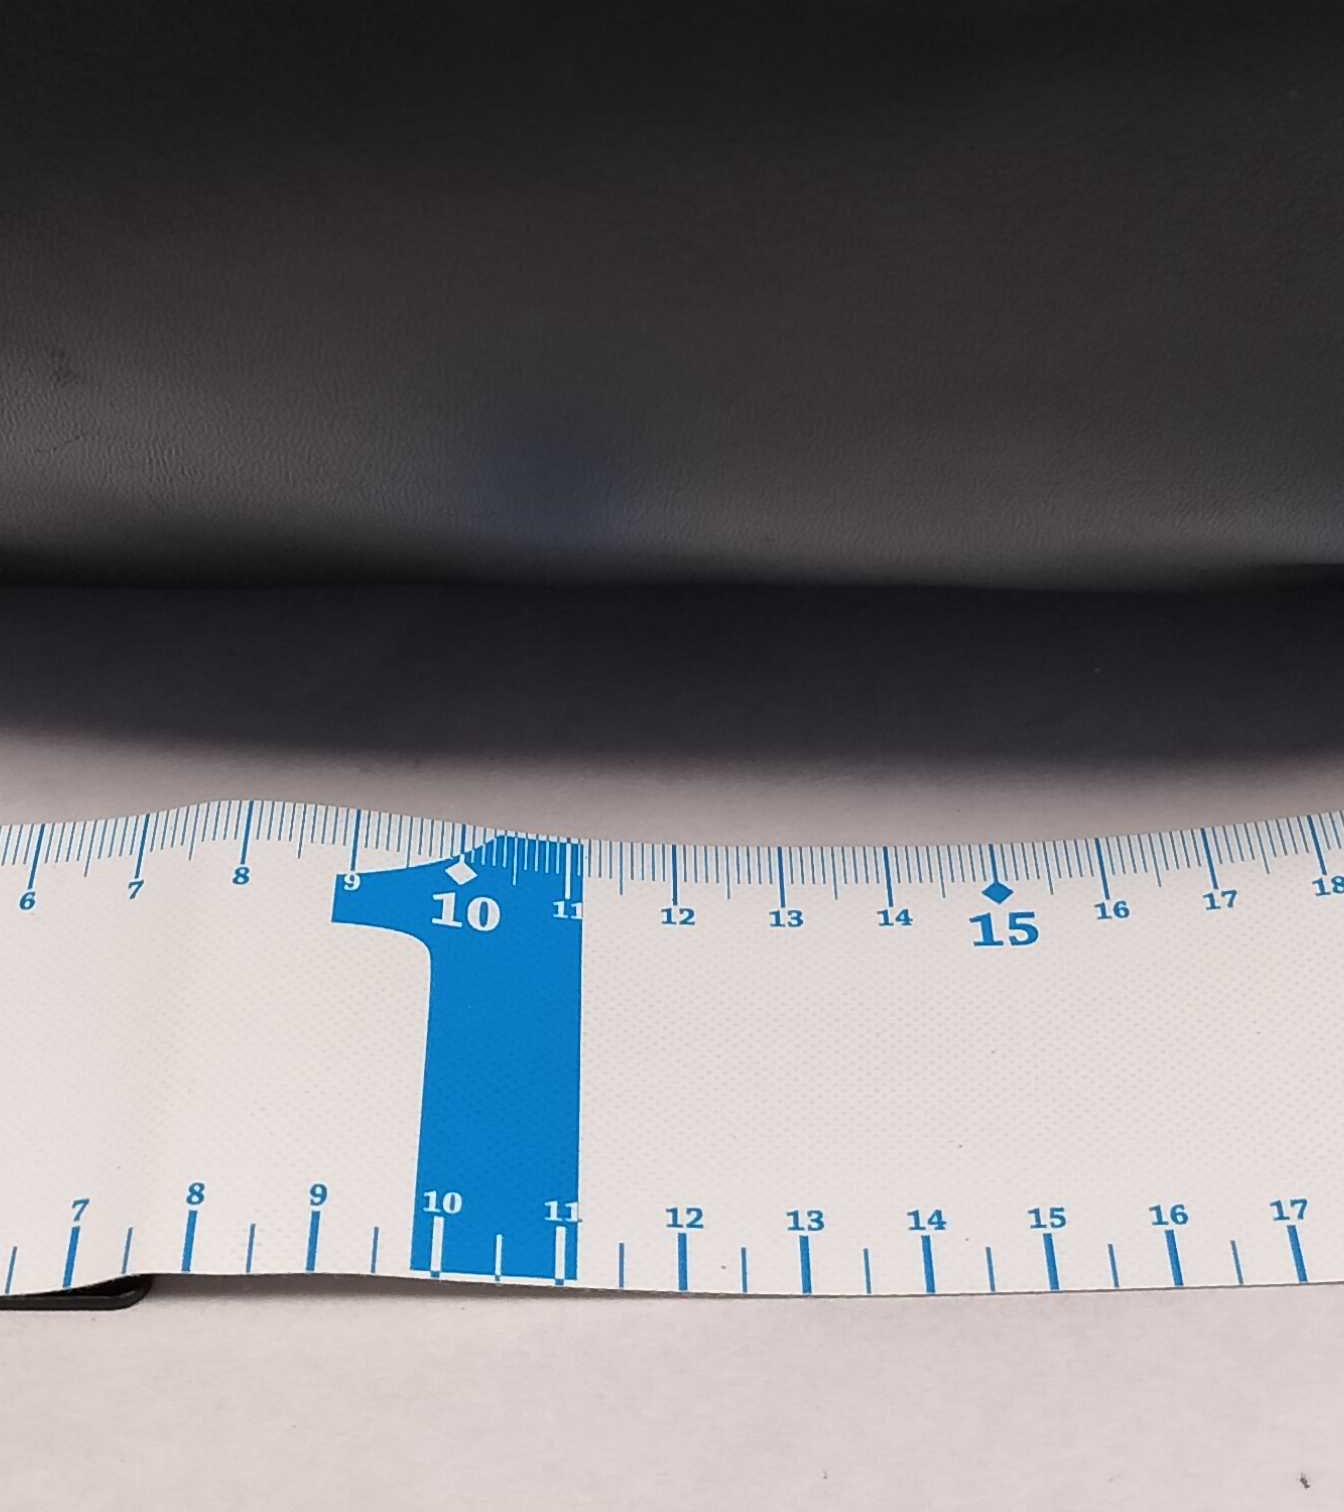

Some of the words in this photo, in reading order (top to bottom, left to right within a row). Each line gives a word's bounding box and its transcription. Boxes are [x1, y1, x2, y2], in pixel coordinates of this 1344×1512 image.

[18, 892, 35, 910] 6
[128, 880, 144, 899] 7
[232, 867, 250, 885] 8
[344, 874, 361, 891] 9
[430, 892, 501, 933] 10
[551, 900, 584, 920] 11
[661, 908, 696, 926] 12
[769, 910, 804, 928] 13
[877, 909, 913, 927] 14
[969, 912, 1039, 947] 15
[1095, 900, 1130, 920] 16
[1203, 889, 1238, 910] 17
[331, 834, 584, 1281] 1
[71, 1199, 90, 1221] 7
[186, 1182, 205, 1205] 8
[309, 1184, 328, 1207] 9
[422, 1192, 463, 1214] 10
[544, 1200, 582, 1222] 11
[665, 1207, 705, 1229] 12
[785, 1210, 826, 1232] 13
[907, 1210, 947, 1231] 14
[1028, 1207, 1067, 1229] 15
[1149, 1204, 1189, 1227] 16
[1269, 1198, 1309, 1221] 17
